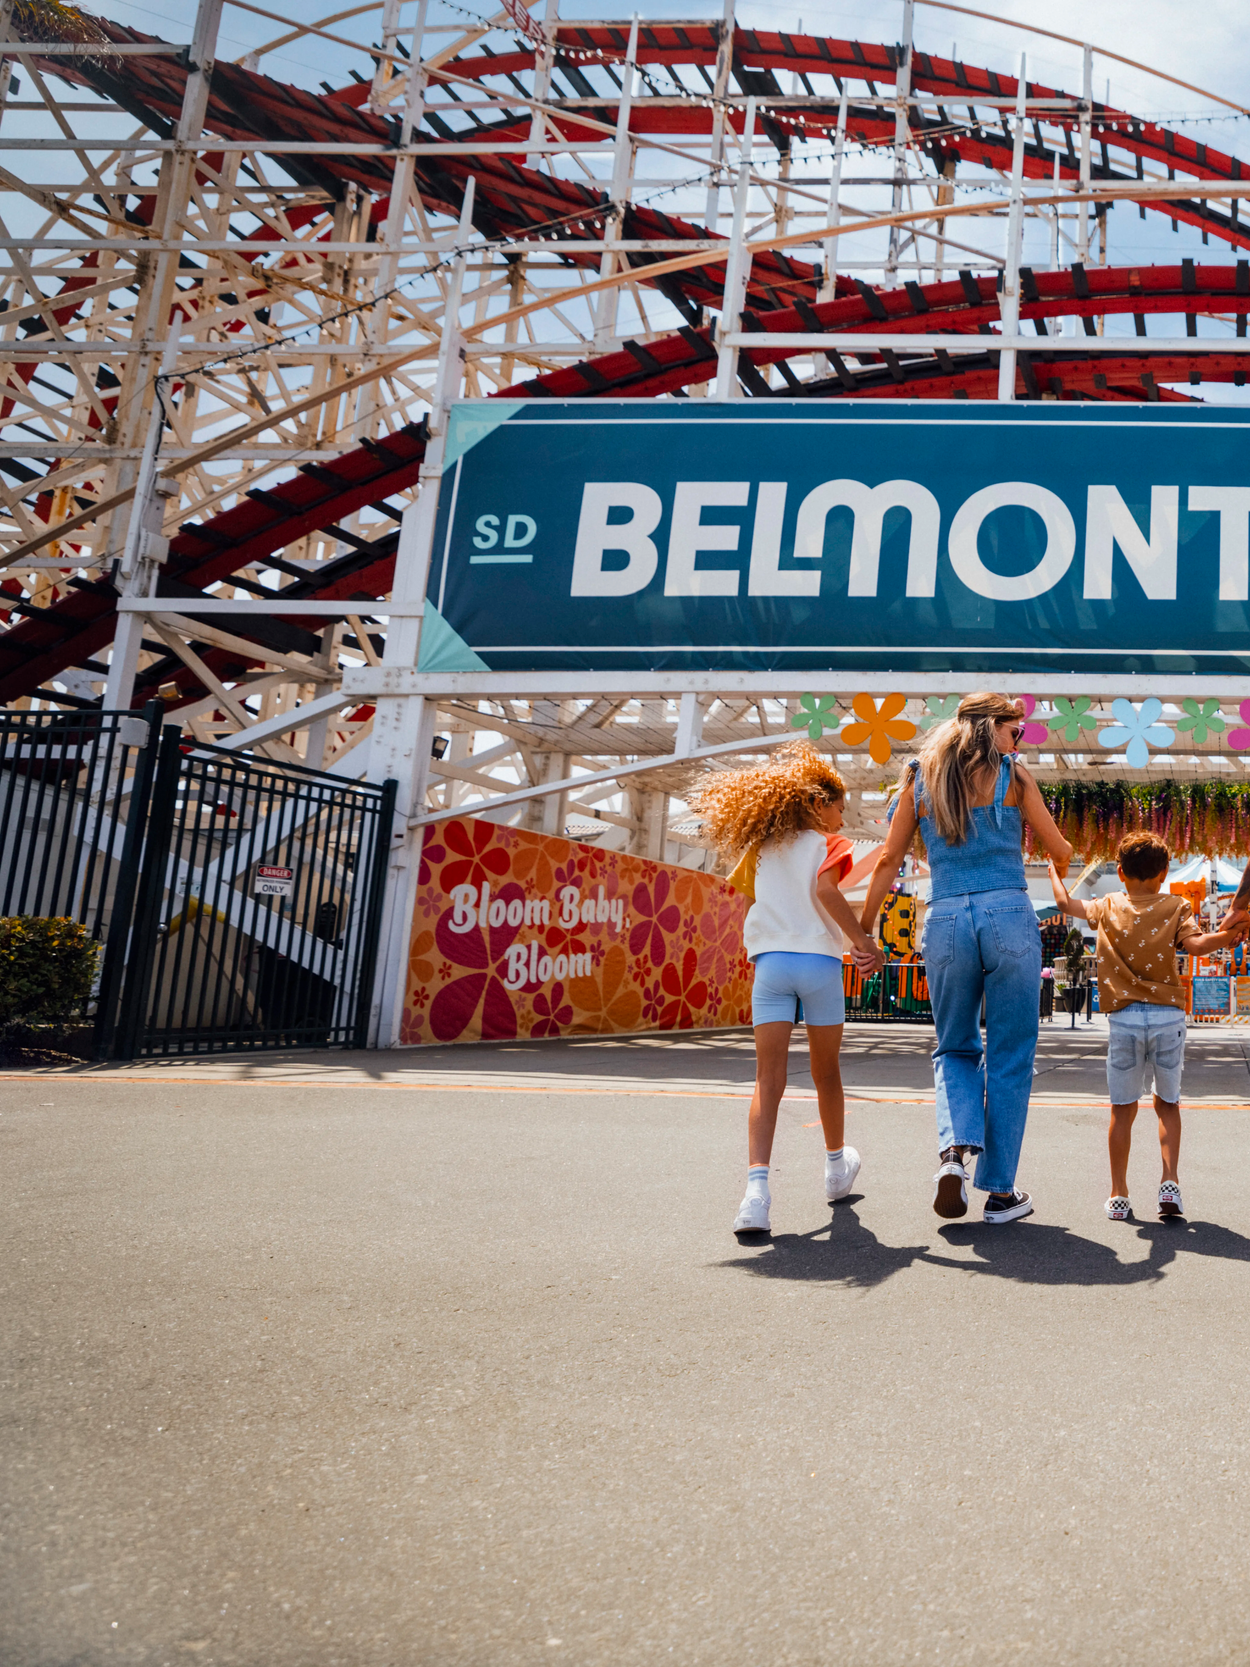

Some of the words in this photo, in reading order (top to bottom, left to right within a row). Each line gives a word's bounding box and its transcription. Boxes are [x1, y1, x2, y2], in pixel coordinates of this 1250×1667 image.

[472, 514, 538, 550] SD
[262, 884, 285, 893] ONLY
[263, 867, 288, 877] DANGER
[448, 881, 550, 934] Bloom
[558, 884, 630, 933] Baby,
[503, 939, 592, 990] Bloom
